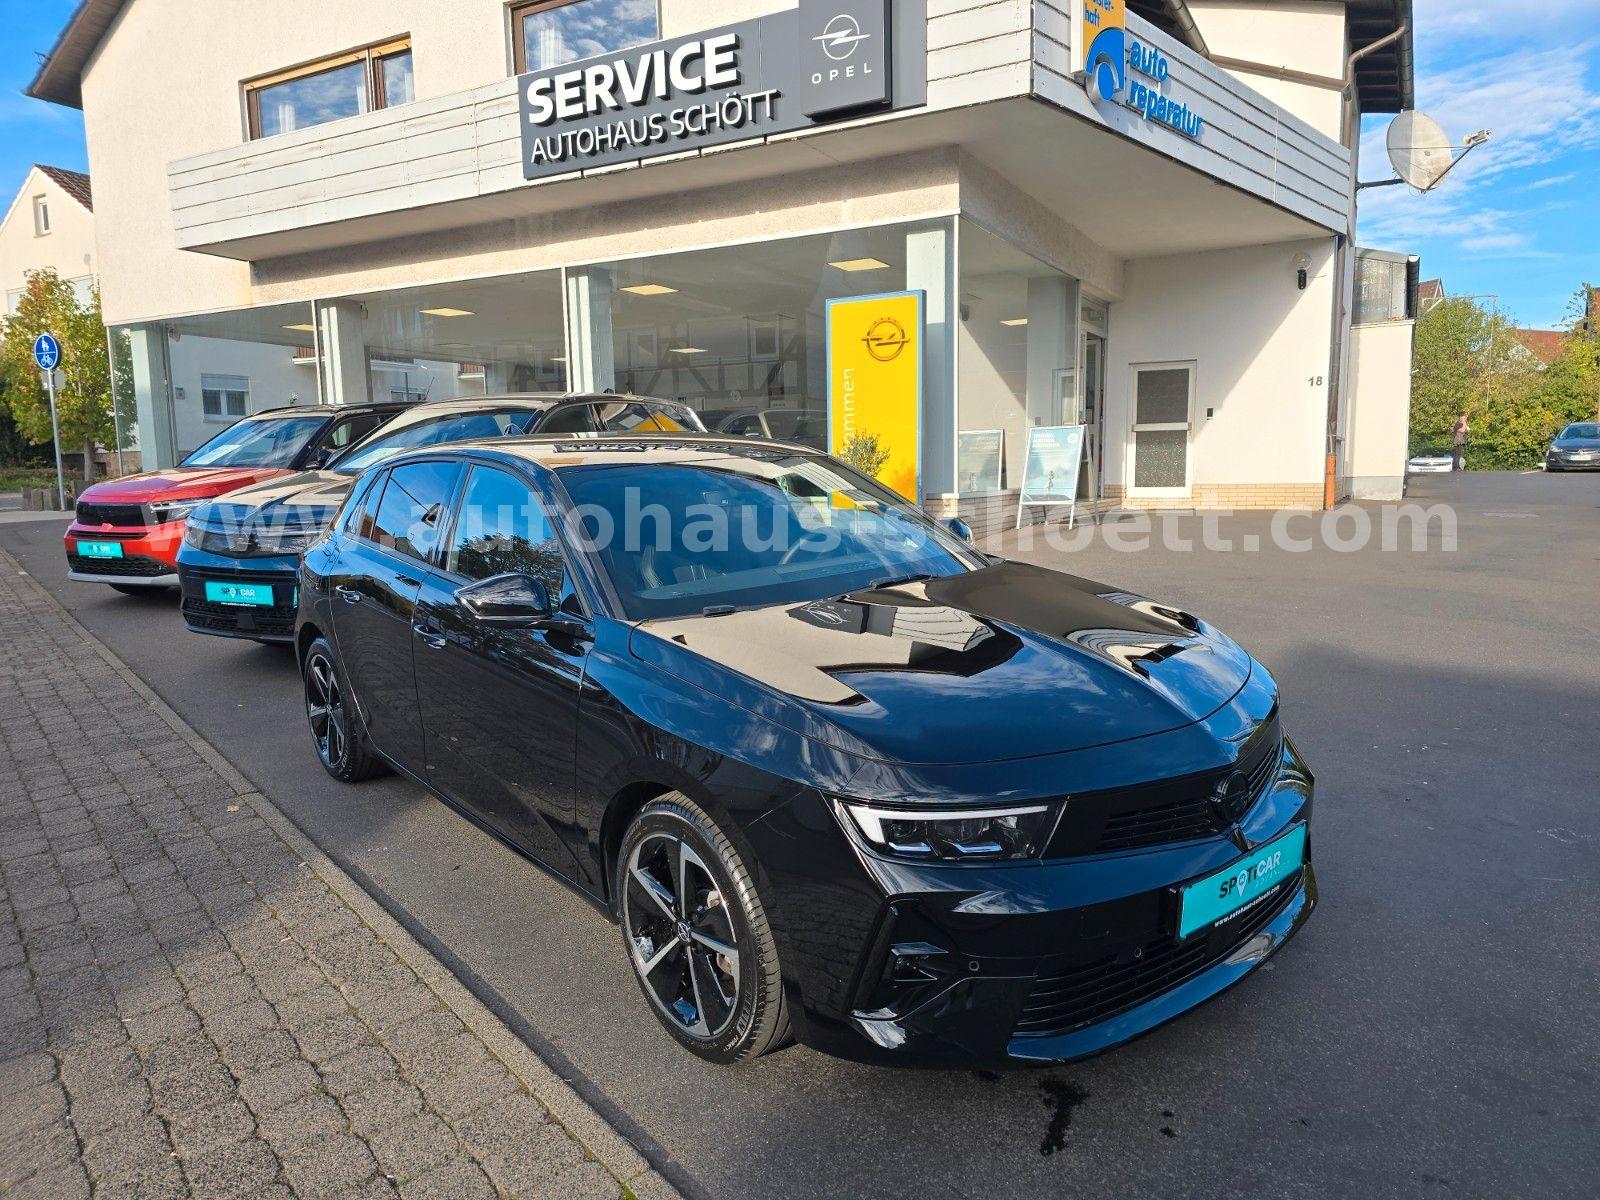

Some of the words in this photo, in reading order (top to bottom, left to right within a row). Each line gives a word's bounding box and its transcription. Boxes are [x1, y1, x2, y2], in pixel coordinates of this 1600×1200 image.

[526, 33, 740, 125] SERVICE
[811, 62, 872, 84] OPEL
[1130, 41, 1168, 82] auto
[531, 112, 664, 164] AUTOHAUS
[670, 88, 779, 137] SCHÖTT
[1128, 80, 1204, 138] reparatur
[843, 368, 856, 448] ommen
[1308, 376, 1323, 387] 18
